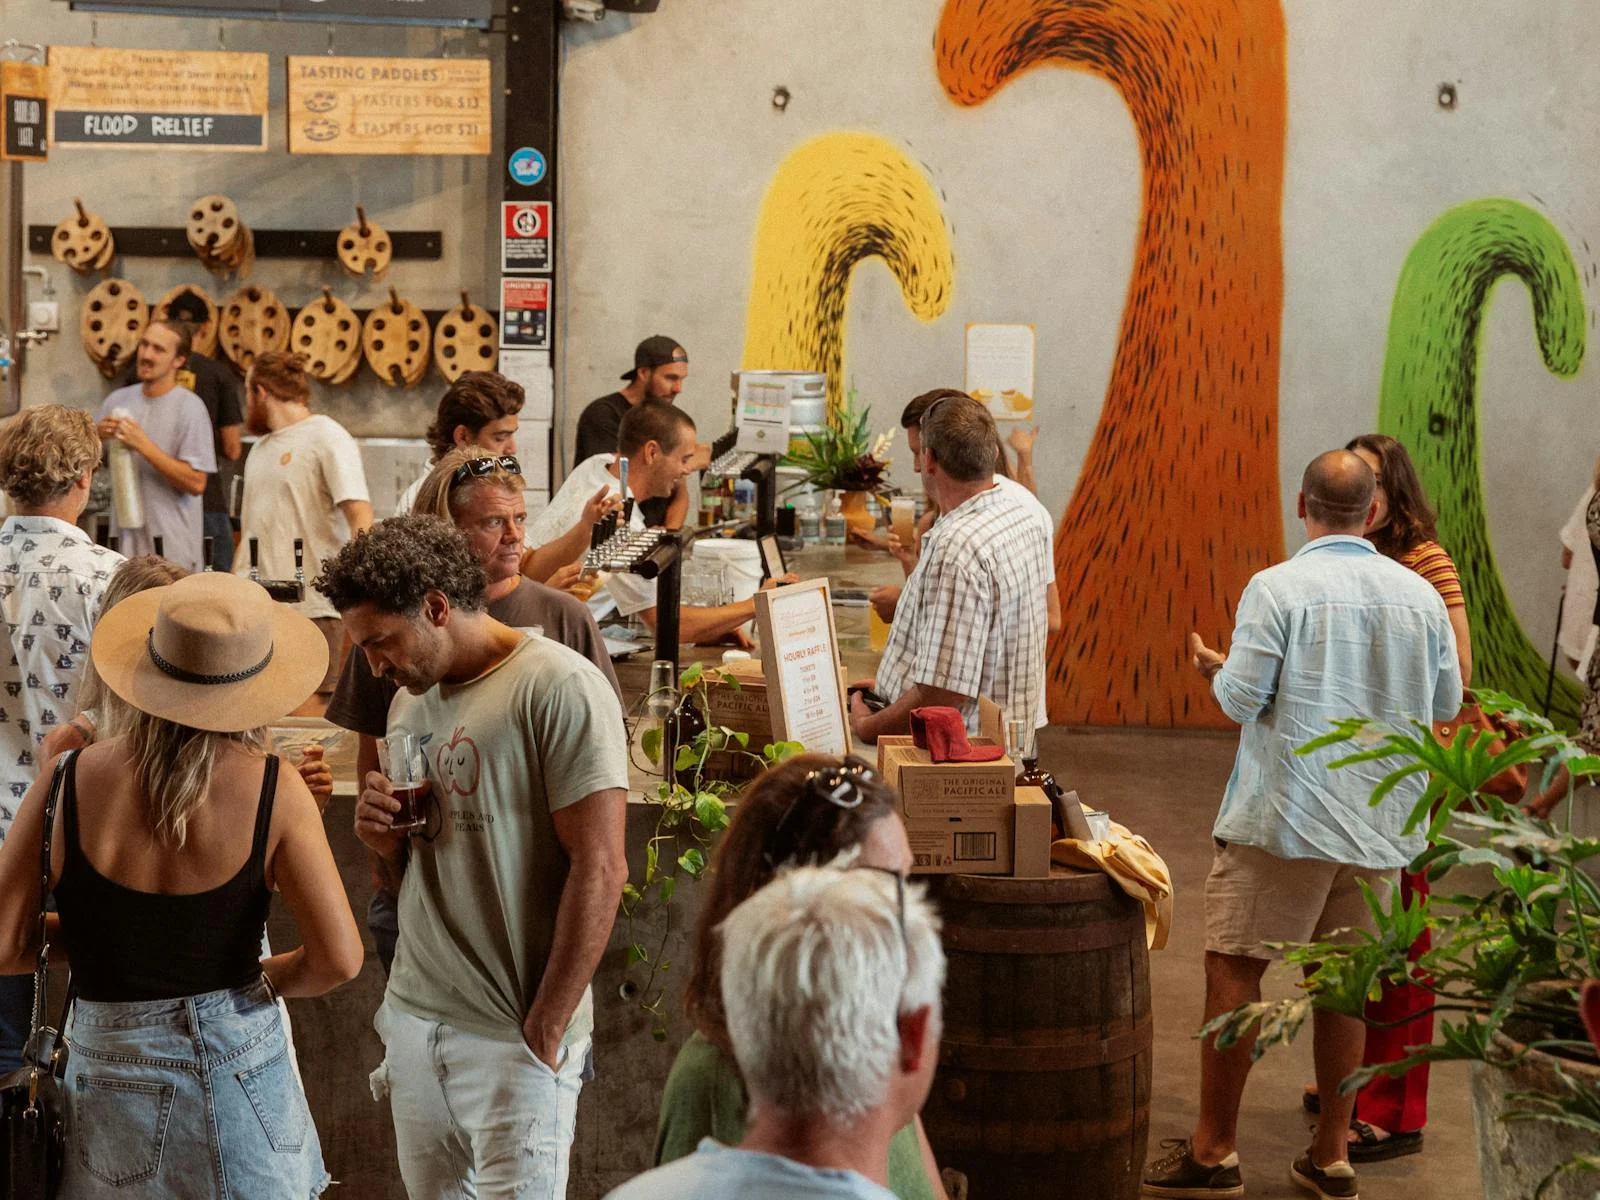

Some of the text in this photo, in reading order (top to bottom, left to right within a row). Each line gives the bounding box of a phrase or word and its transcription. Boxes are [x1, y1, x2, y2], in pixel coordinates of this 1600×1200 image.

[300, 66, 366, 80] TASTING
[371, 67, 439, 82] PADDLES
[363, 95, 419, 108] TASTERS
[425, 96, 452, 108] FOR
[84, 114, 214, 137] FLOOD RELIEF
[363, 122, 419, 136] TASTERS
[425, 124, 452, 135] FOR
[783, 643, 827, 662] HOURLY RAFFLE
[717, 701, 752, 712] PACIFIC
[943, 778, 1007, 786] THE ORIGINAL
[944, 786, 984, 796] PACIFIC
[988, 786, 1007, 796] ALE
[455, 822, 485, 832] PEARS
